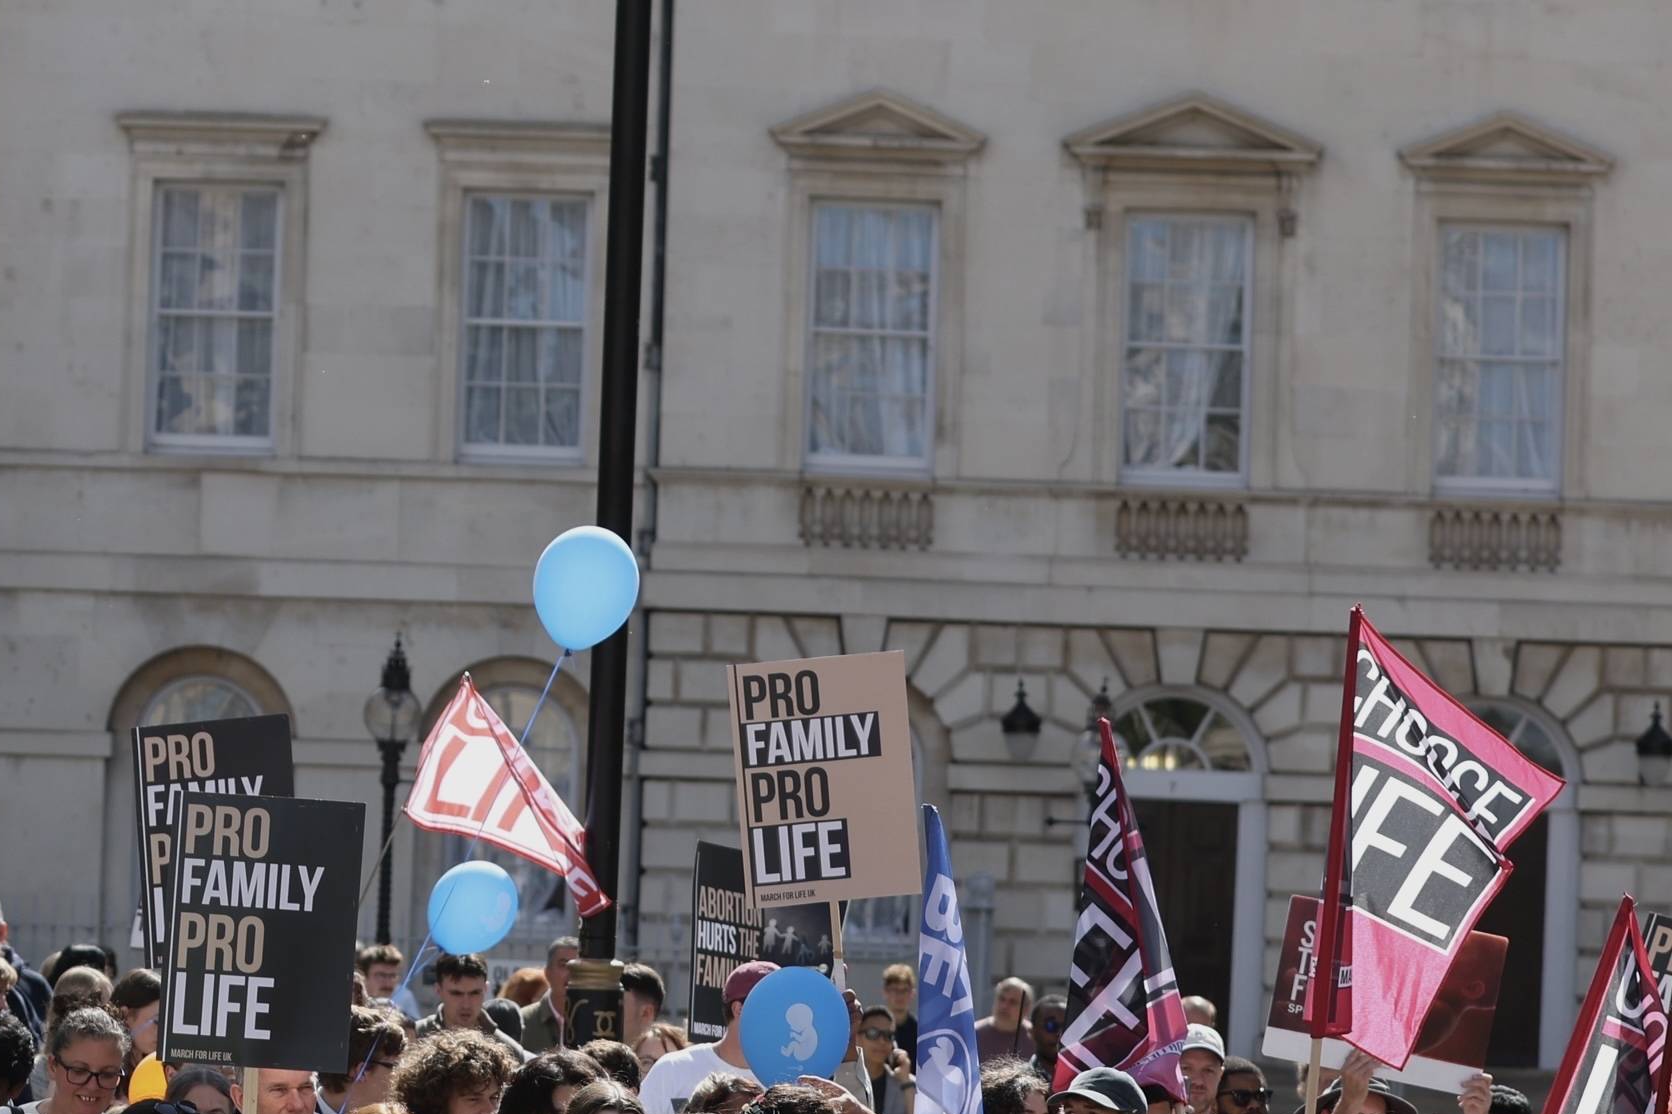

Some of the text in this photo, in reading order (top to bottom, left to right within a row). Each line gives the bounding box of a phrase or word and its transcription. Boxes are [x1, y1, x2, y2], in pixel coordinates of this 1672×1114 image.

[742, 669, 821, 721] PRO
[143, 731, 216, 782] PRO
[745, 712, 876, 766] FAMILY
[750, 766, 831, 823] PRO
[184, 803, 271, 859] PRO
[752, 820, 847, 884] LIFE
[181, 858, 325, 912] FAMILY
[698, 885, 763, 928] ABORTION
[760, 893, 782, 902] MARCH
[782, 891, 794, 901] FOR
[807, 888, 816, 897] UK
[176, 912, 265, 974] PRO
[697, 919, 760, 959] HURTS THE
[172, 972, 275, 1040] LIFE
[170, 1048, 233, 1062] MARCH FOR LIFE UK
